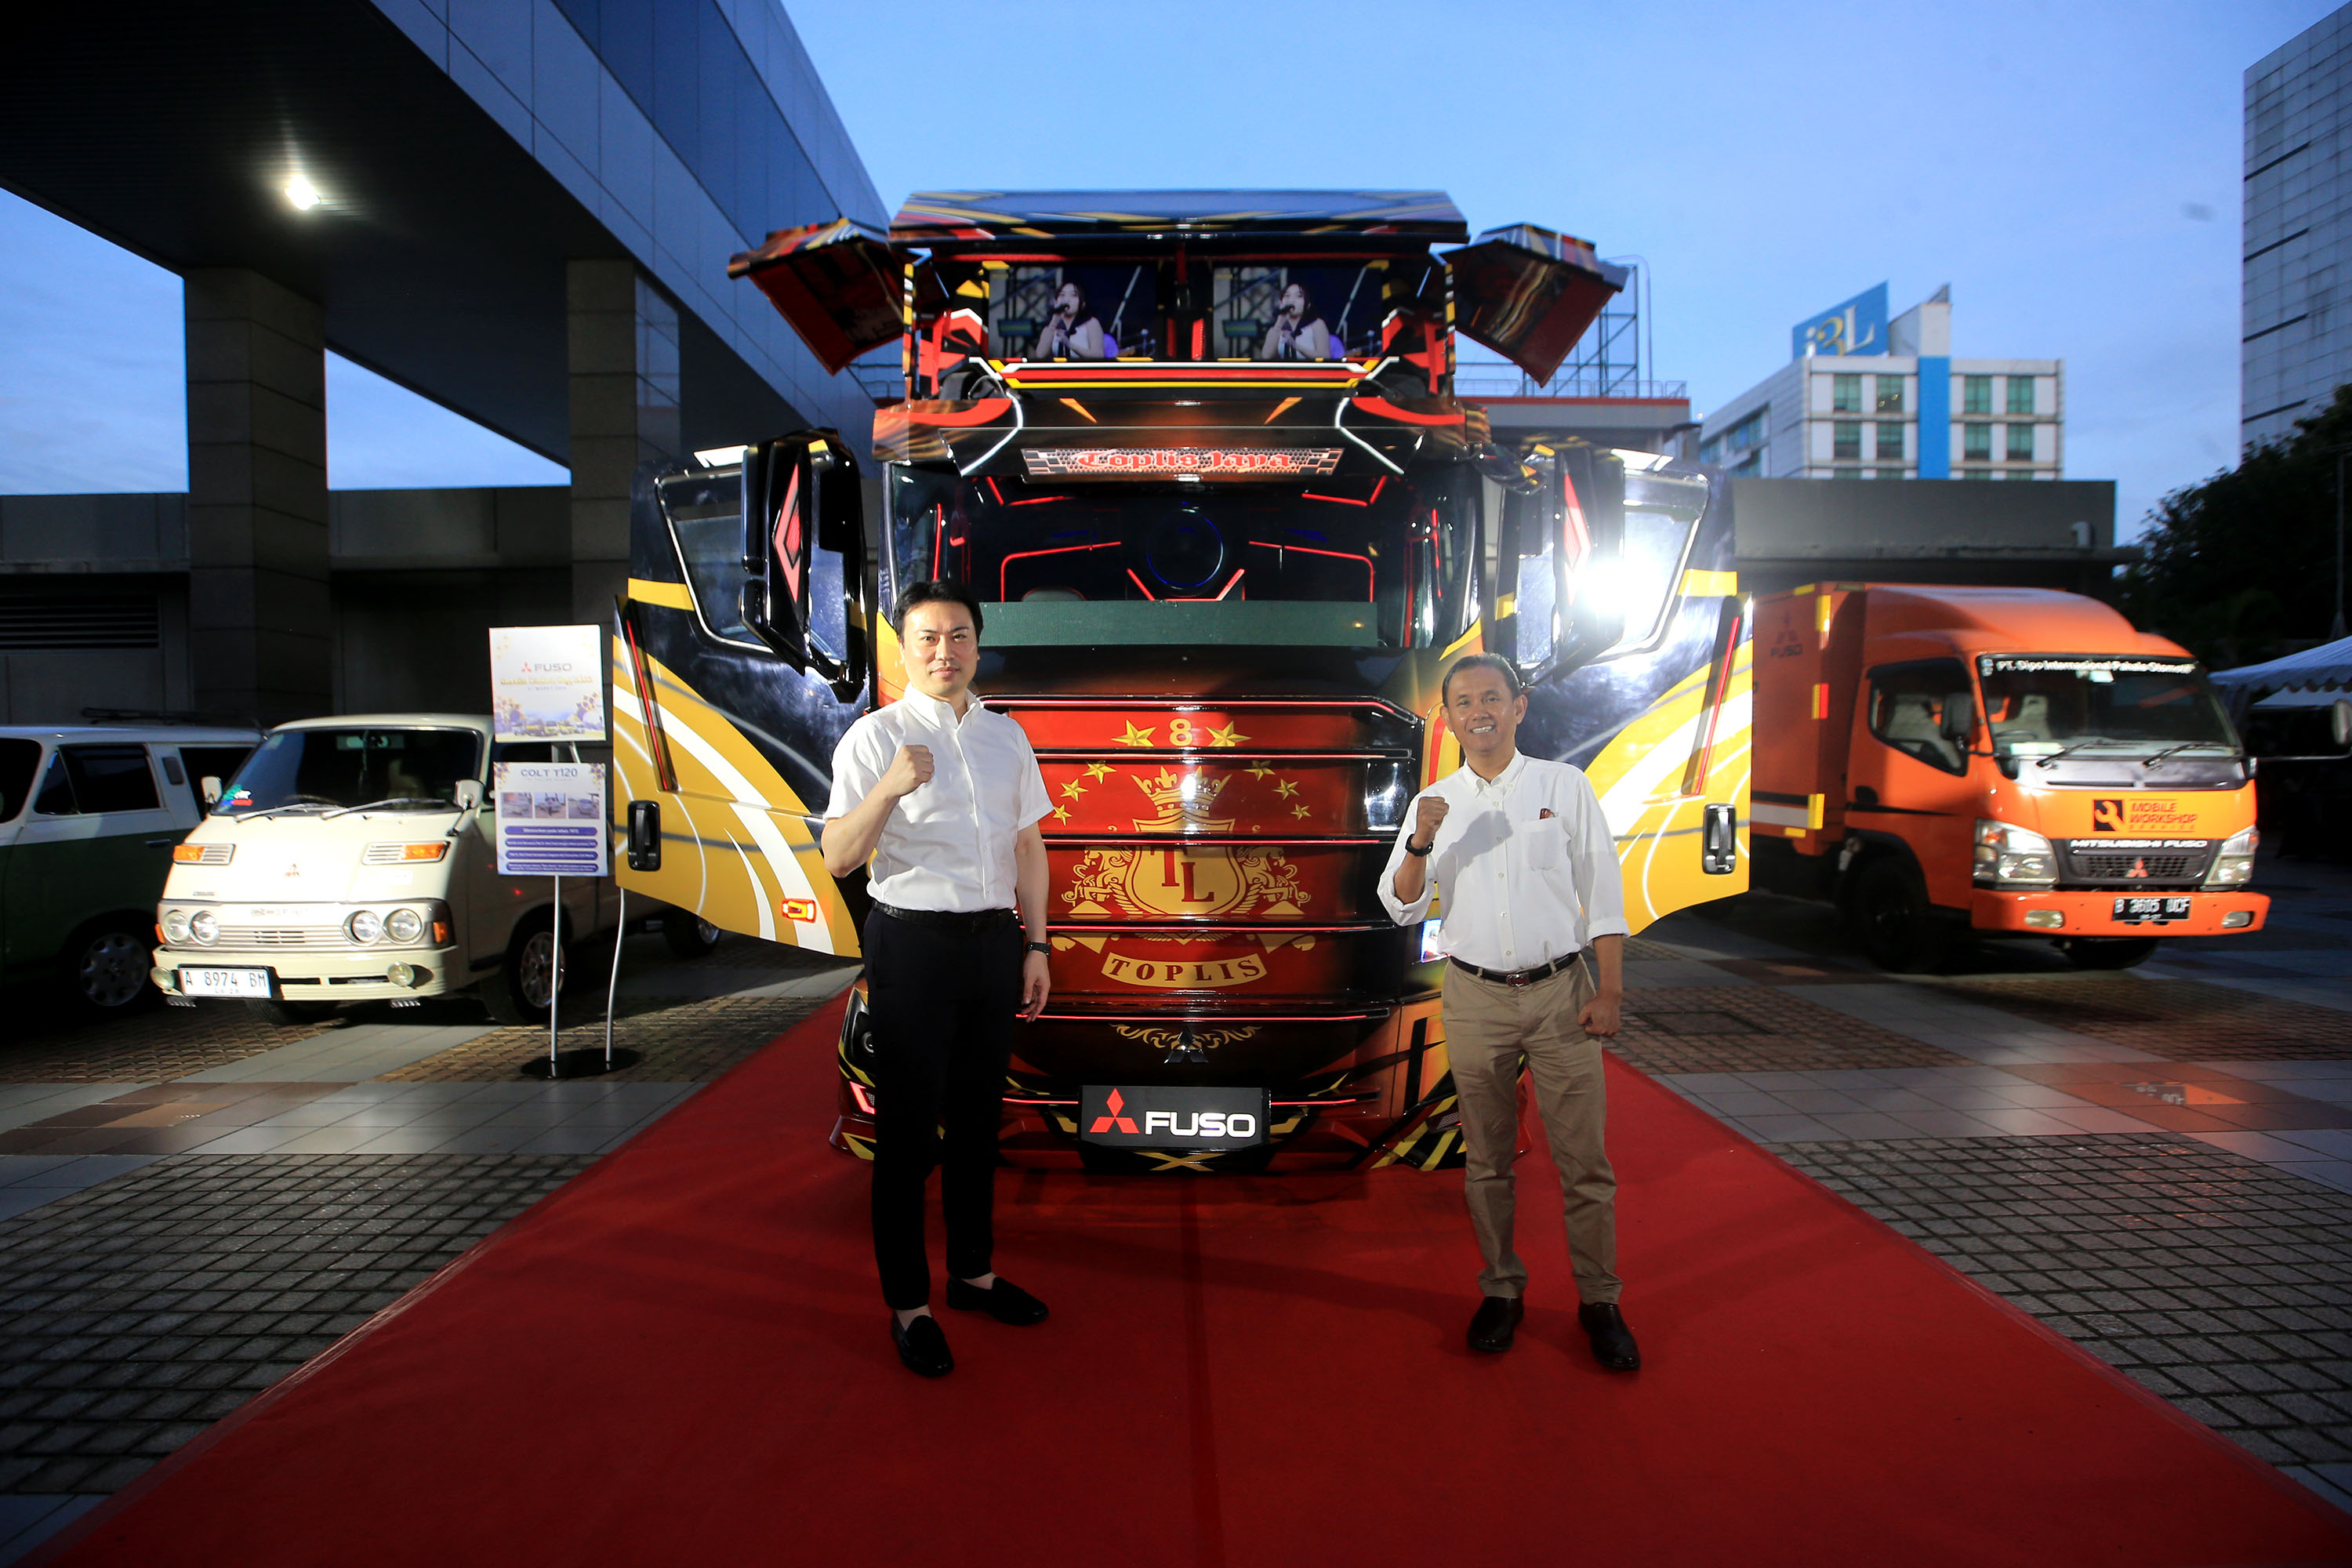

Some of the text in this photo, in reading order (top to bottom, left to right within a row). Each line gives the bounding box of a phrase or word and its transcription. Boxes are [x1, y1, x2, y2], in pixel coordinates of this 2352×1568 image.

[1069, 448, 1295, 474] Toplis Jaya
[535, 662, 572, 672] FUSO
[1169, 718, 1192, 746] 8
[521, 768, 578, 777] COLT T120
[2132, 803, 2177, 812] MOBILE
[2130, 814, 2197, 823] WORKSHOP
[2114, 898, 2125, 913] B
[1109, 957, 1261, 982] TOPLIS
[185, 971, 267, 987] A 8974 BM
[1144, 1110, 1256, 1138] FUSO
